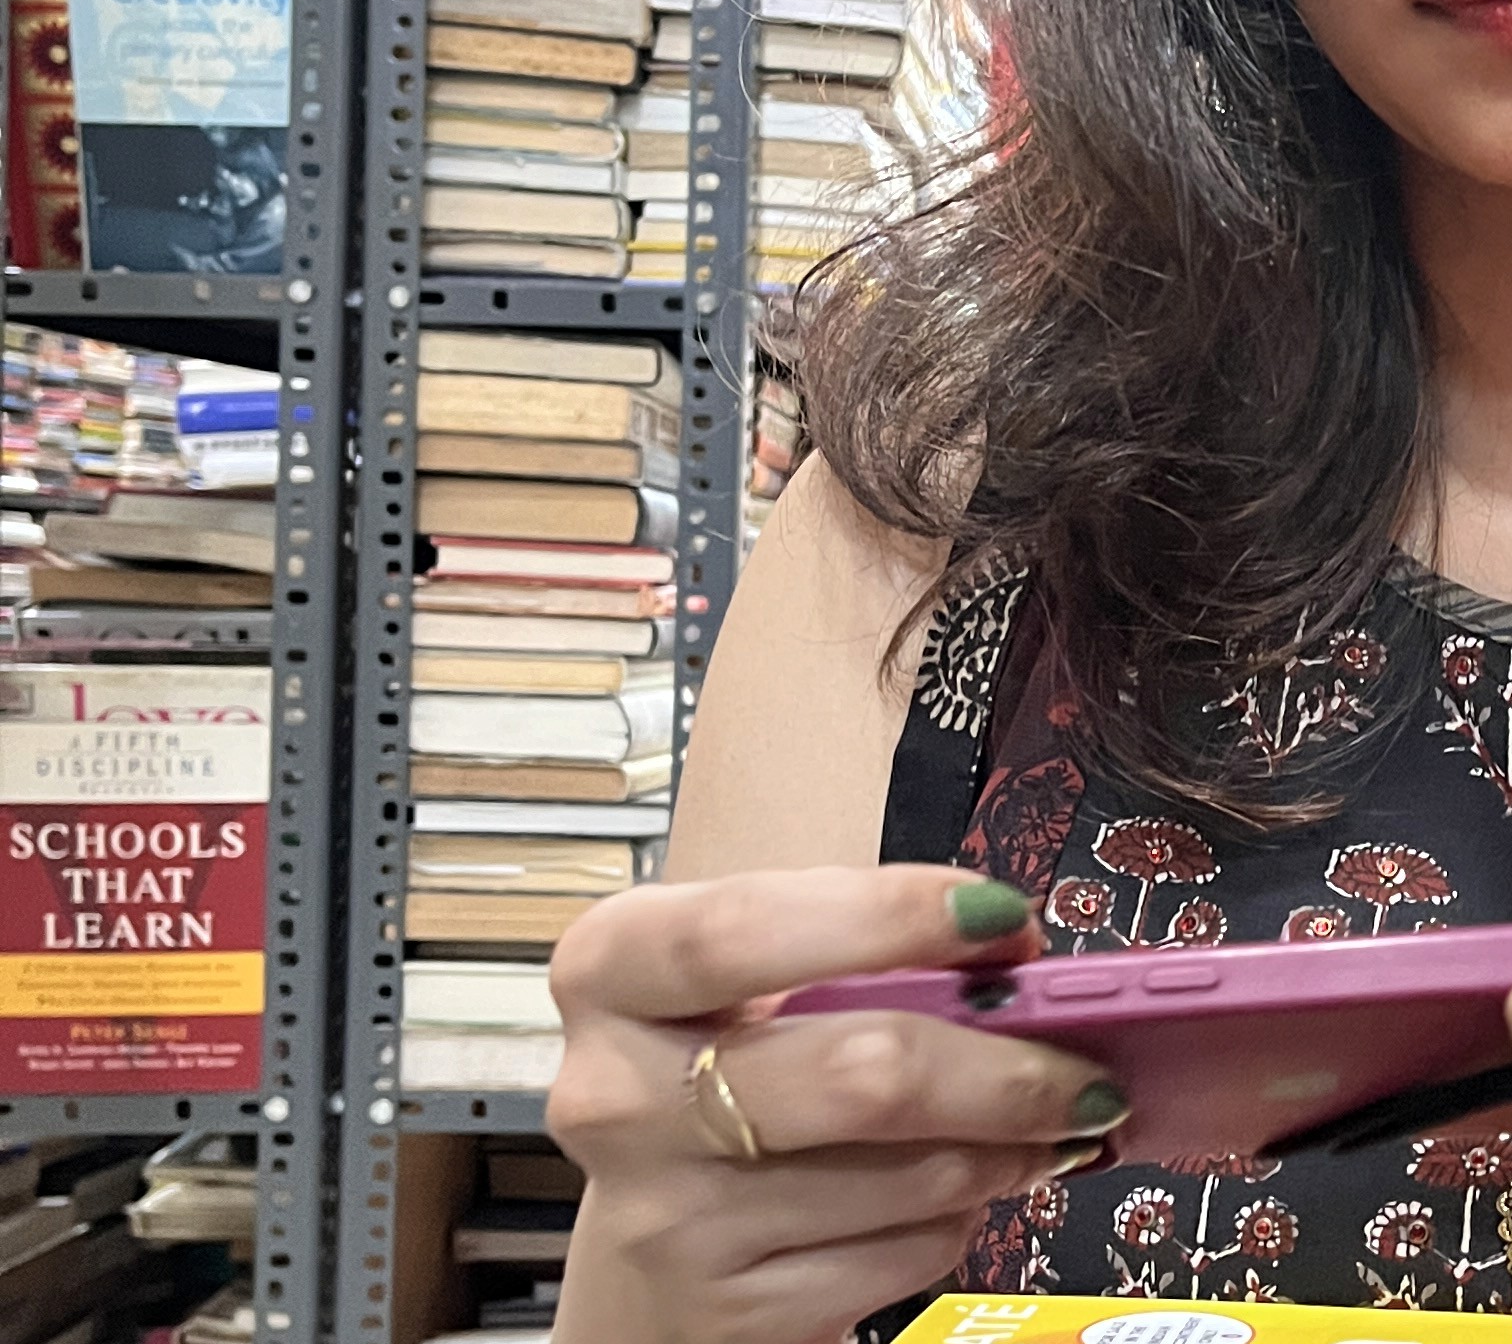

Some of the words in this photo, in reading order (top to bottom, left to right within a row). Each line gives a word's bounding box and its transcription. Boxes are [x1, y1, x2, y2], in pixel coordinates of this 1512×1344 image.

[95, 730, 182, 749] FIFTH
[35, 758, 216, 778] DISCIPLINE
[9, 822, 247, 862] SCHOOLS
[61, 867, 194, 905] THAT
[43, 912, 215, 950] LEARN
